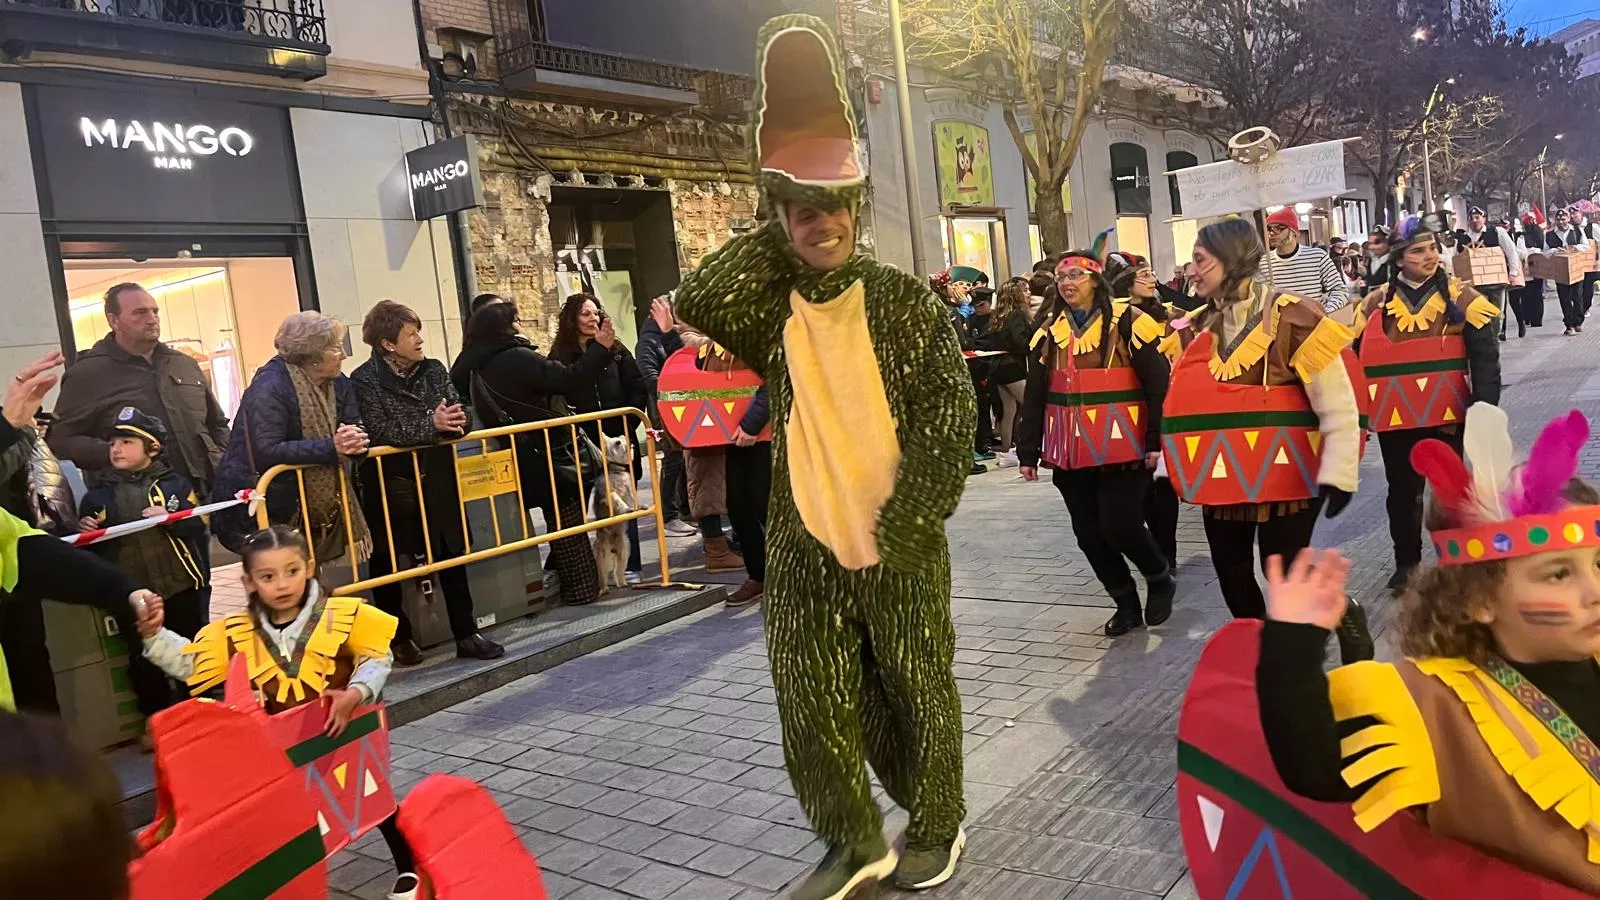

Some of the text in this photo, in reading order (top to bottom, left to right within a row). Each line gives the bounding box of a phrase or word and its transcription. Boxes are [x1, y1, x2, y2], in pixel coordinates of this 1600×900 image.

[79, 116, 252, 157] MANGO
[153, 156, 193, 170] MAN
[411, 159, 469, 190] MANGO
[434, 183, 448, 192] MAN
